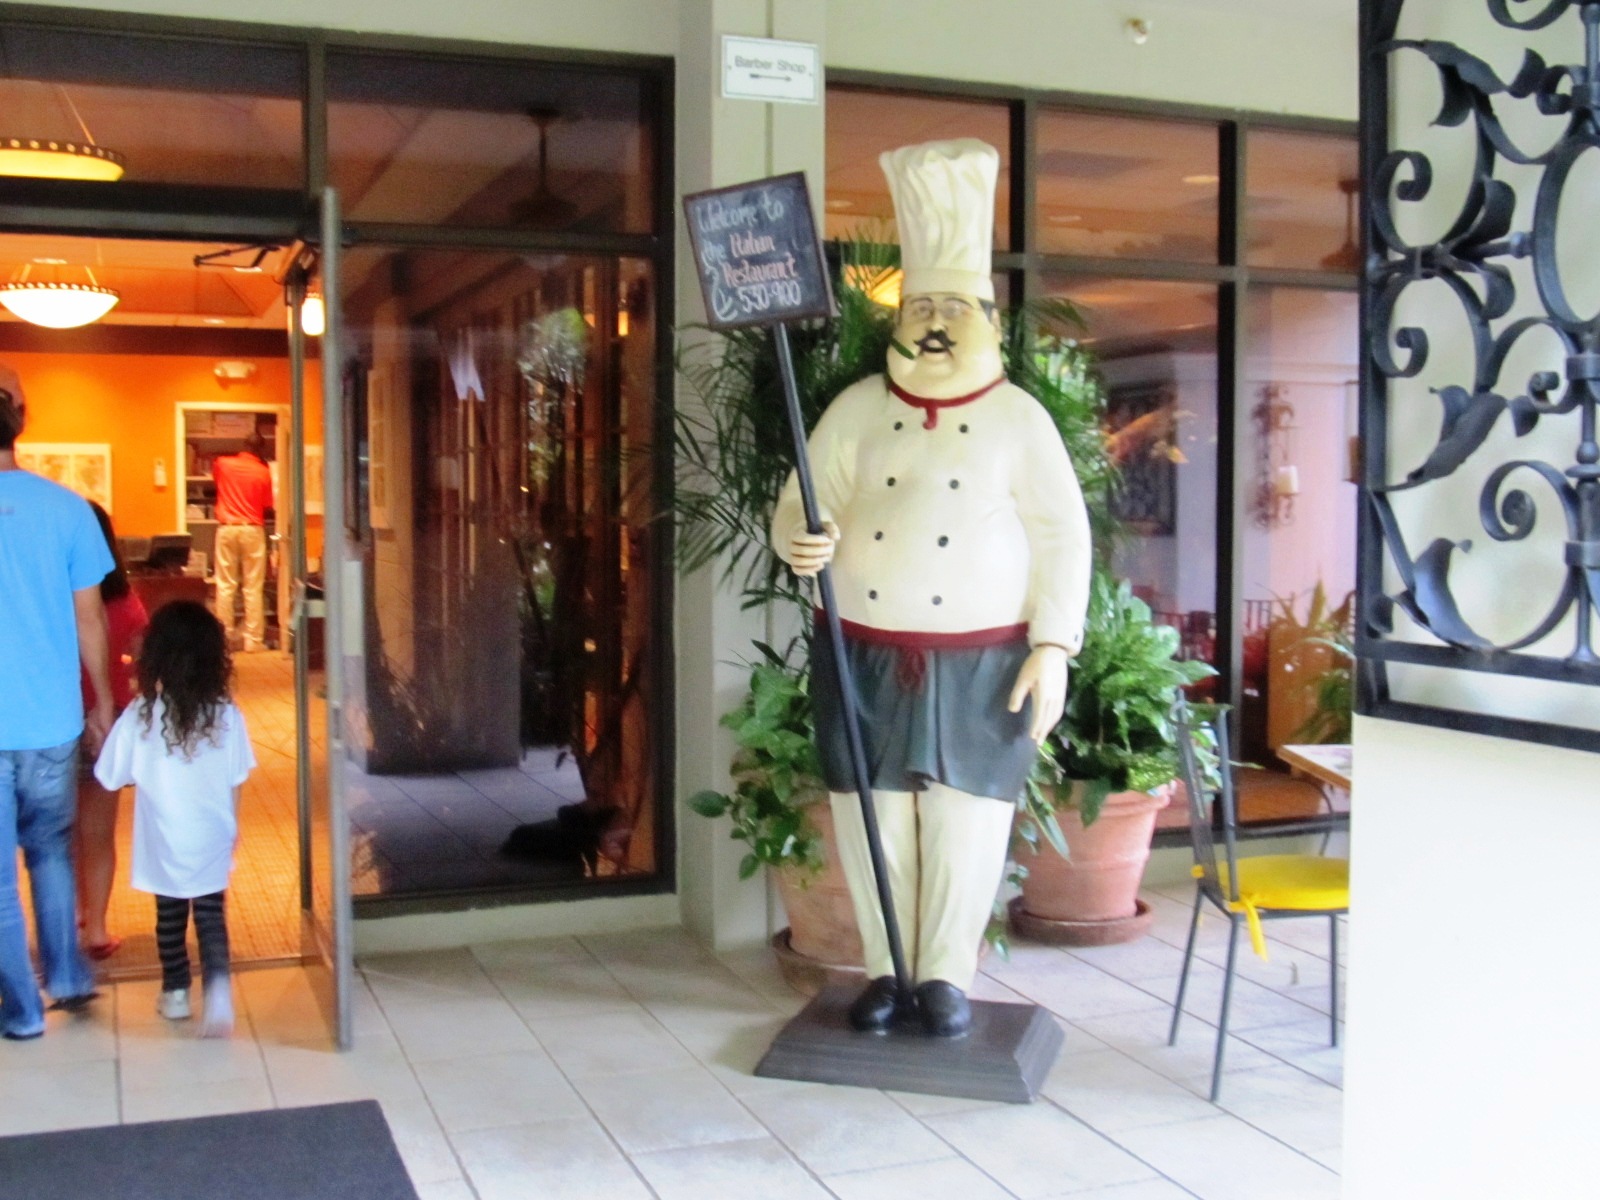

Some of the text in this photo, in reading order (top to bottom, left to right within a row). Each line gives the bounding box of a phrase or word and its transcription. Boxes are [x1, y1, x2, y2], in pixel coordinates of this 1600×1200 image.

[735, 55, 806, 74] Barber Shop
[763, 190, 784, 221] to
